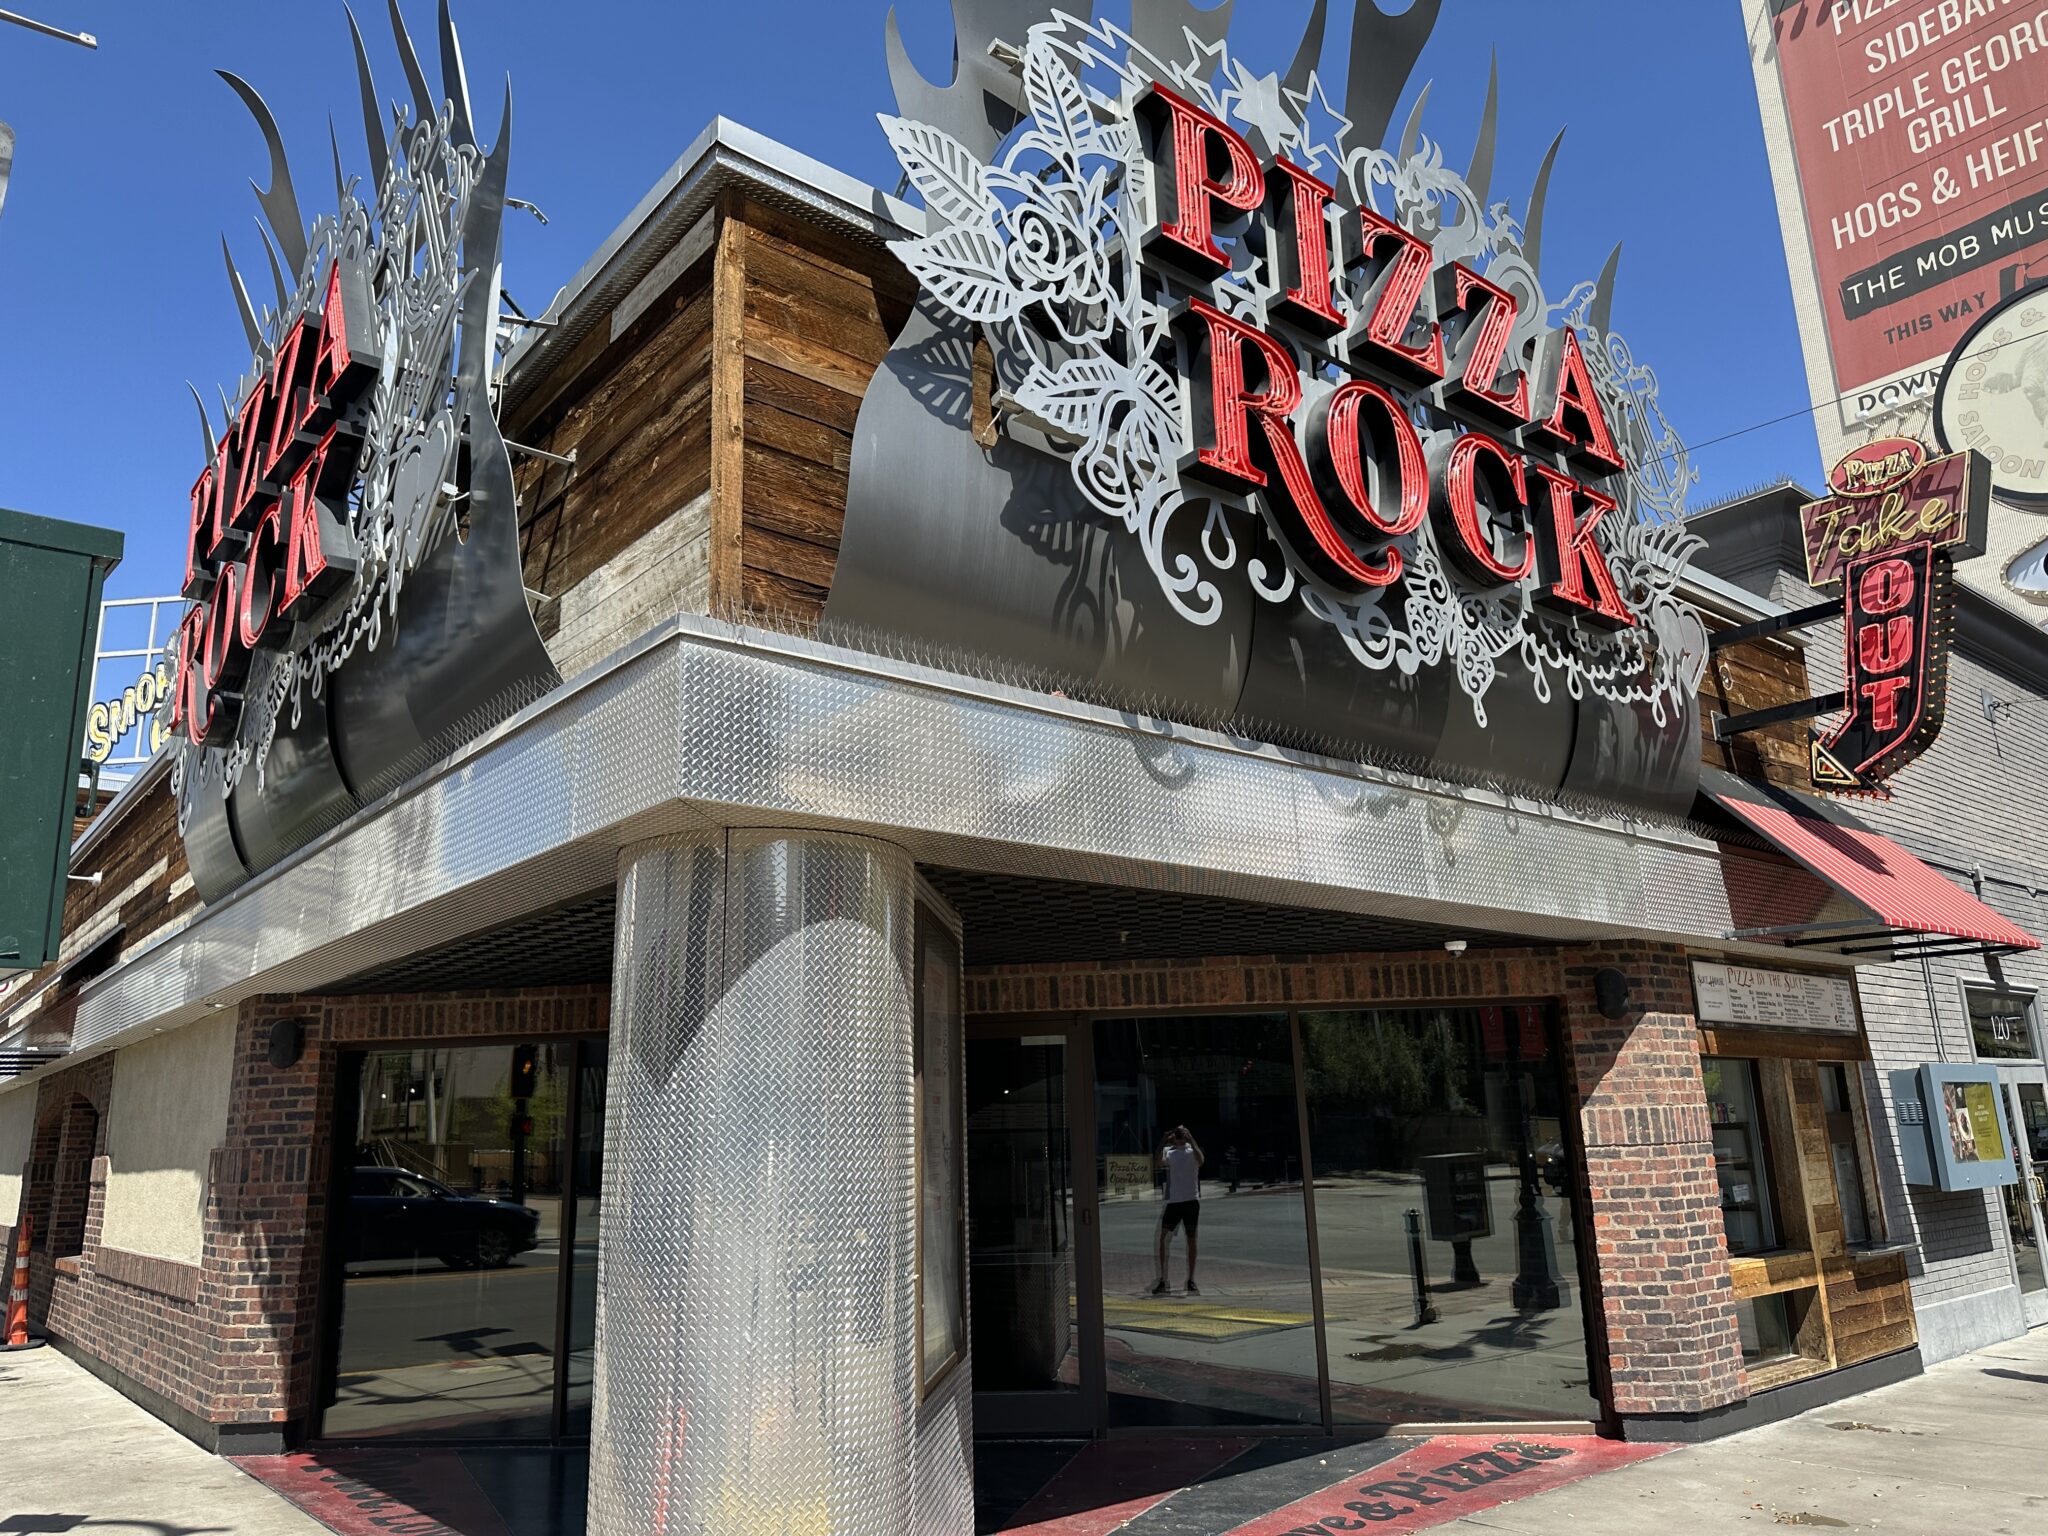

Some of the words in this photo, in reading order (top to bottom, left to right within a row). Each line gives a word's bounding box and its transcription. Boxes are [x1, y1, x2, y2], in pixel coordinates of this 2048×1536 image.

[1865, 0, 2010, 74] SIDEBA
[1822, 71, 1935, 152] TRIPLE
[1907, 84, 2007, 154] GRILL
[1831, 181, 1922, 250] HOGS
[1931, 166, 1961, 205] &
[1966, 117, 2048, 189] HEIF
[1149, 81, 1626, 474] PIZZA
[1847, 265, 1905, 304] THE
[1916, 235, 1980, 277] MOB
[1883, 313, 1933, 345] THIS
[1937, 291, 1986, 323] WAY
[1958, 328, 2013, 401] HOGS
[181, 257, 351, 597] PIZZA
[1189, 297, 1636, 628] ROCK
[1958, 410, 2045, 479] SALOON
[1843, 448, 1915, 490] PIZZA
[1814, 492, 1959, 567] Take
[170, 421, 338, 746] ROCK
[1858, 559, 1914, 732] OUT
[1727, 967, 1755, 987] PIZZA
[1768, 973, 1782, 987] THE
[1990, 1015, 2010, 1041] 120
